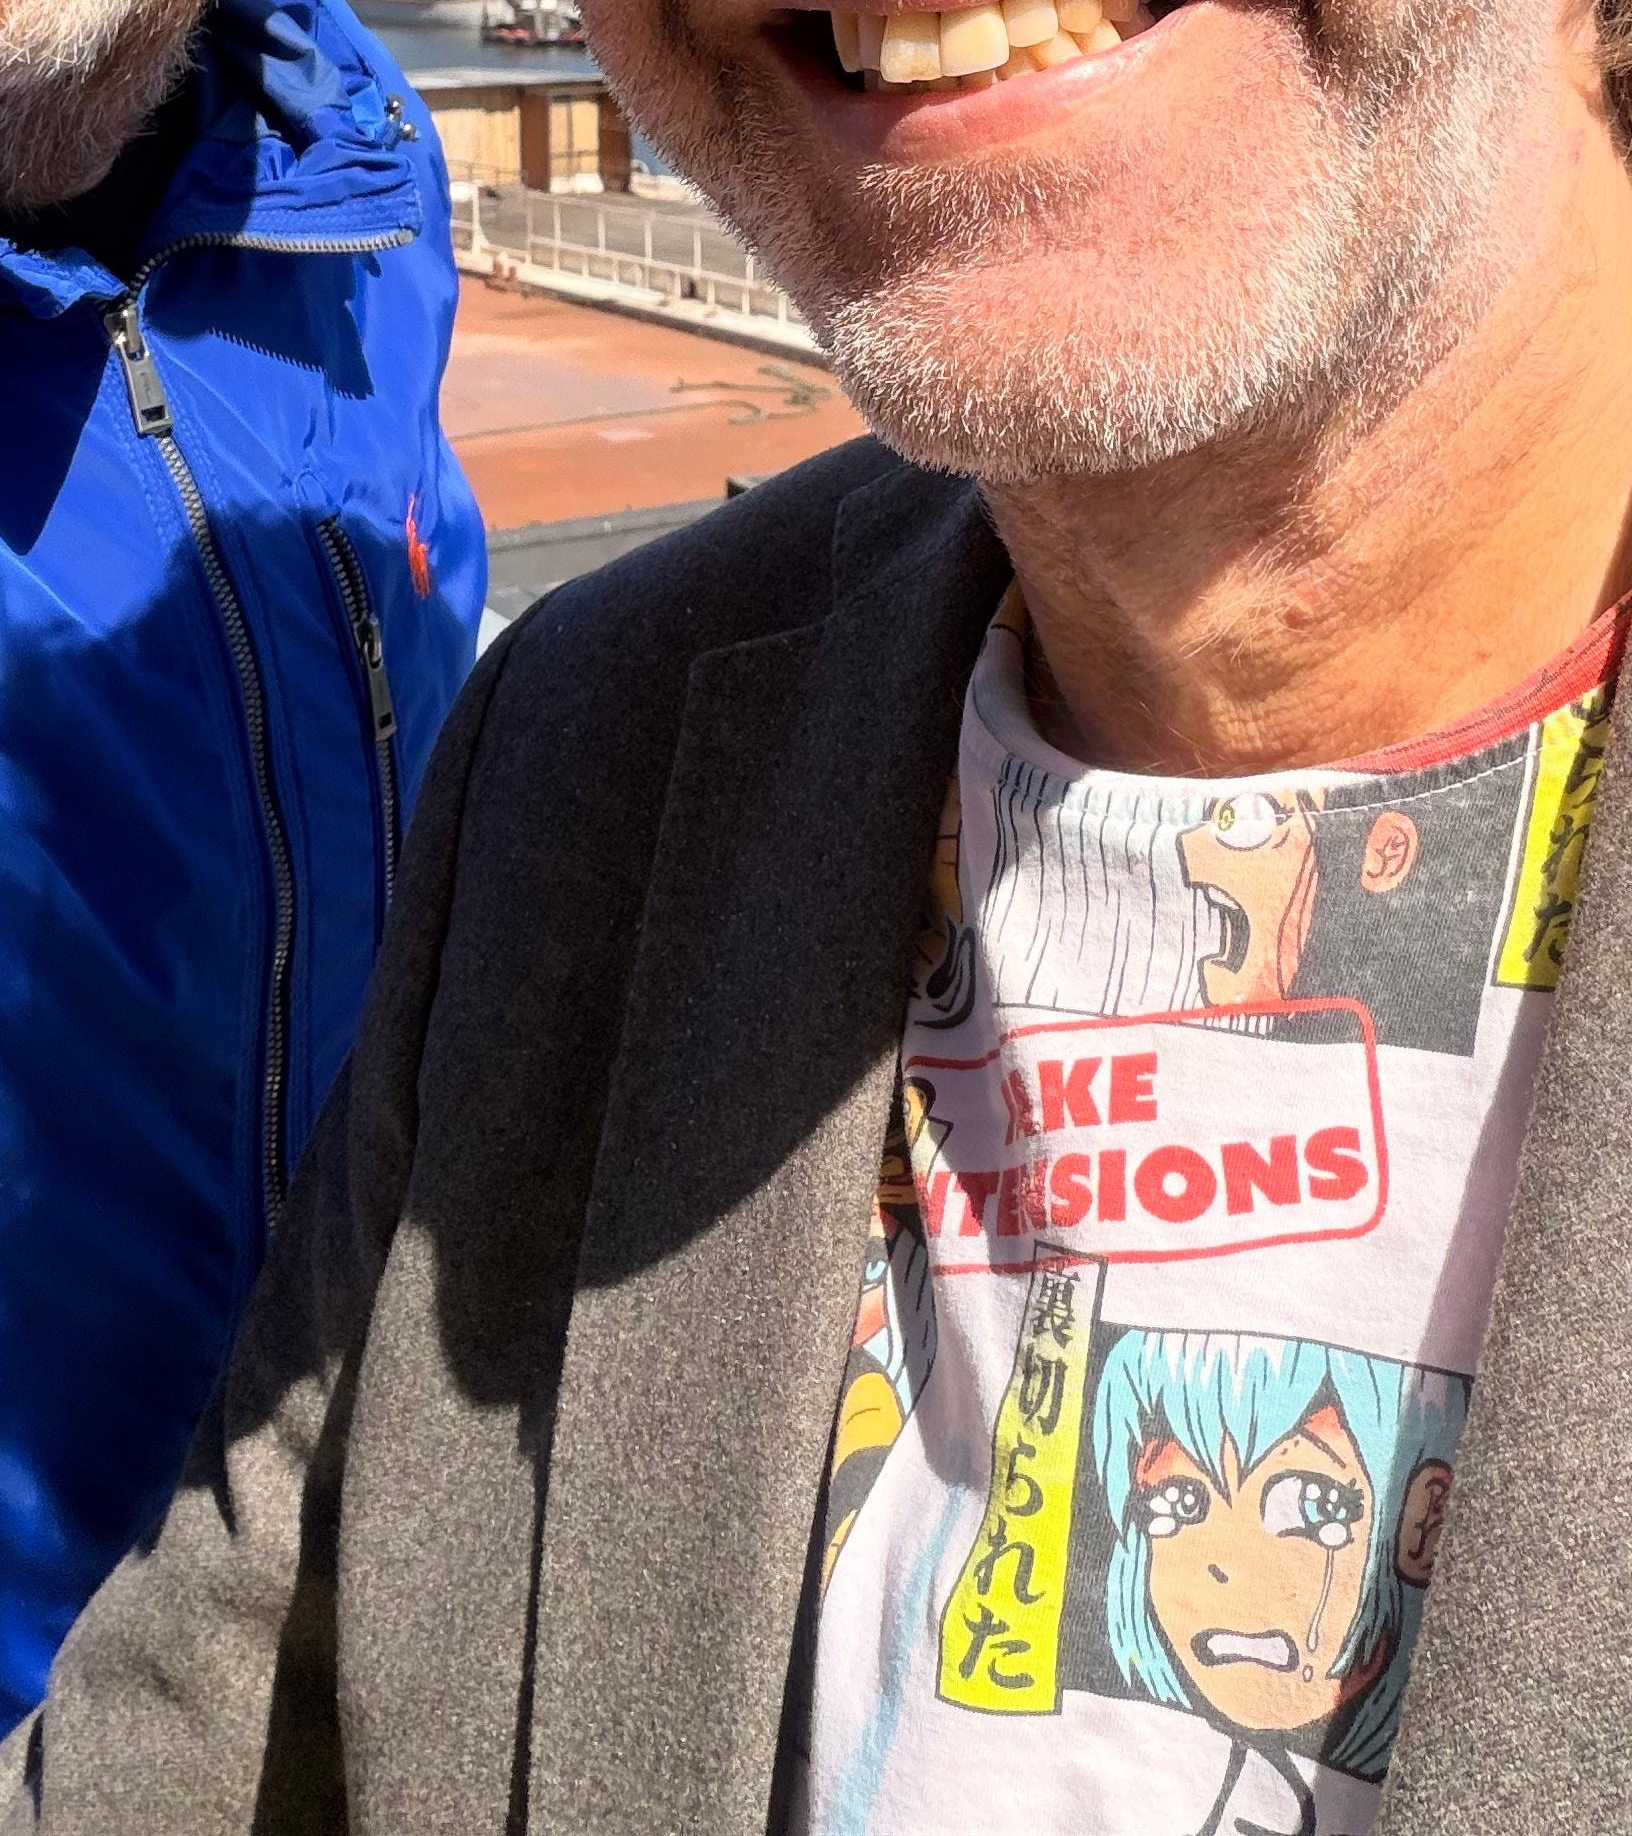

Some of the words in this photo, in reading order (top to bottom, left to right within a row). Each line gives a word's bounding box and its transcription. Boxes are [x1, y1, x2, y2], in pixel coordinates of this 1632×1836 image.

[962, 1260, 1081, 1690] 裏切られた
